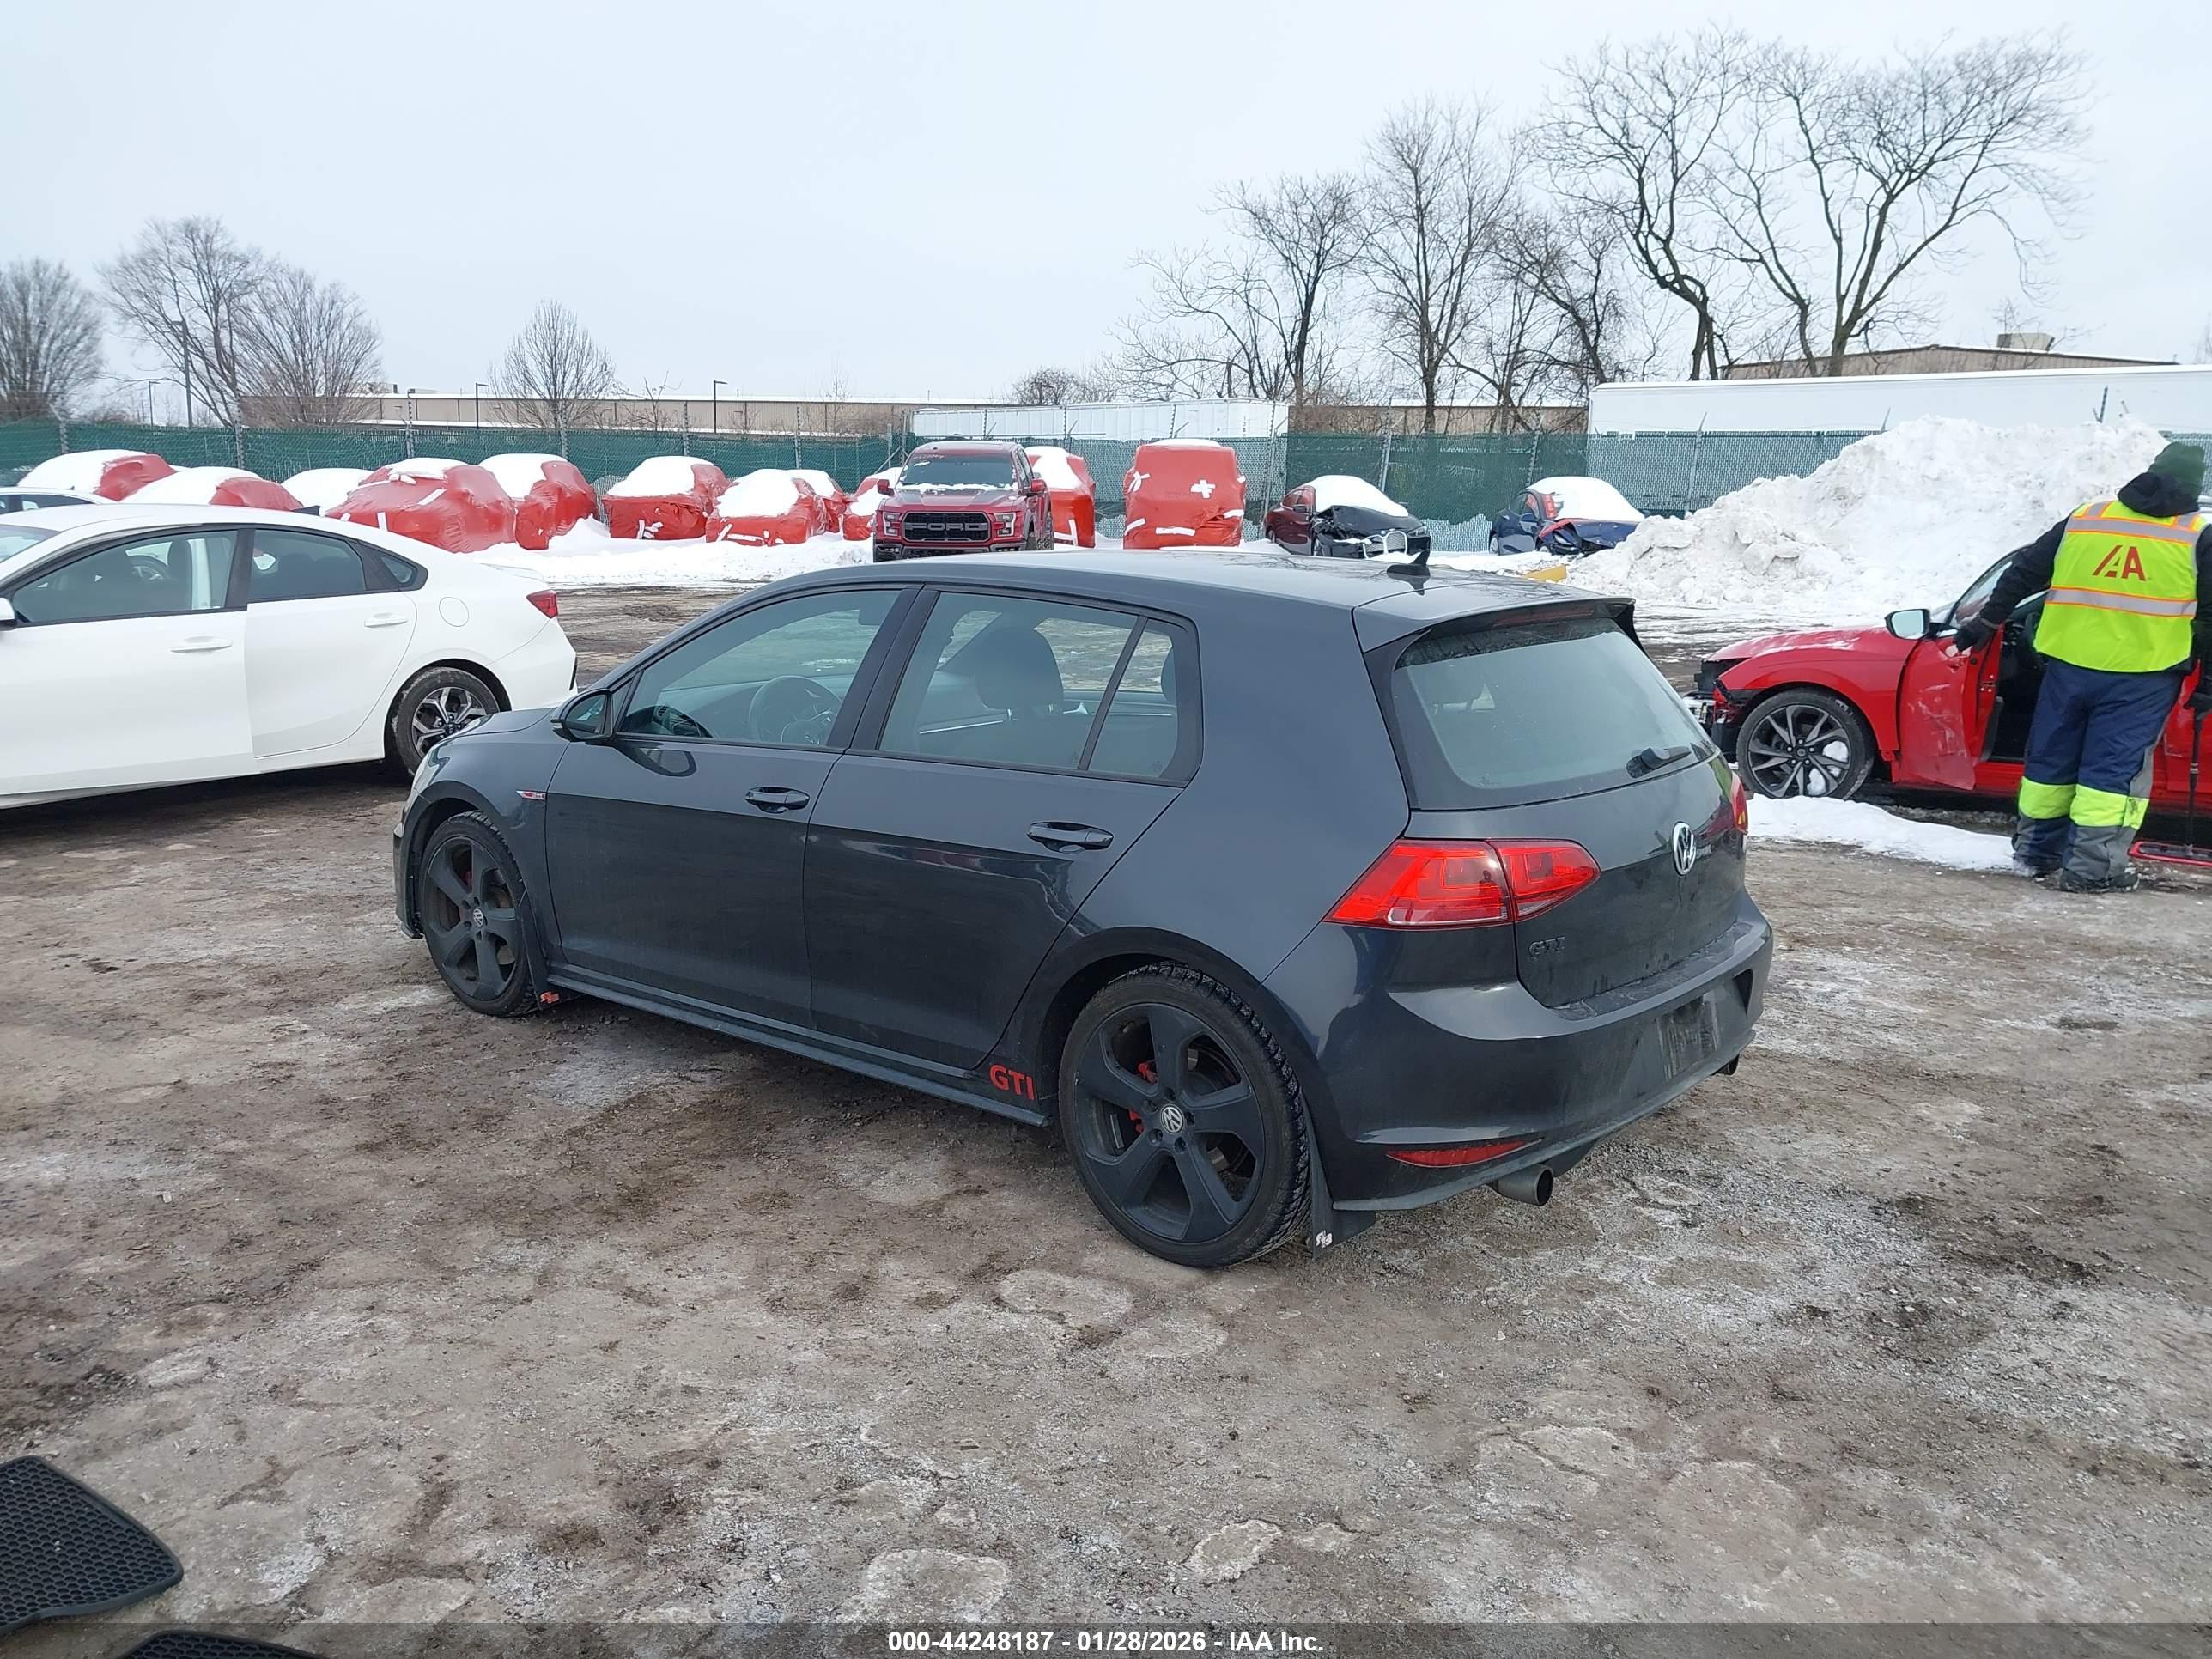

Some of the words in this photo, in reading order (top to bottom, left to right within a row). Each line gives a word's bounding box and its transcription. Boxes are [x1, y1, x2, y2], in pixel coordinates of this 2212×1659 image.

[904, 522, 988, 531] FORD
[1528, 936, 1565, 958] GTI
[989, 1064, 1035, 1100] GTI
